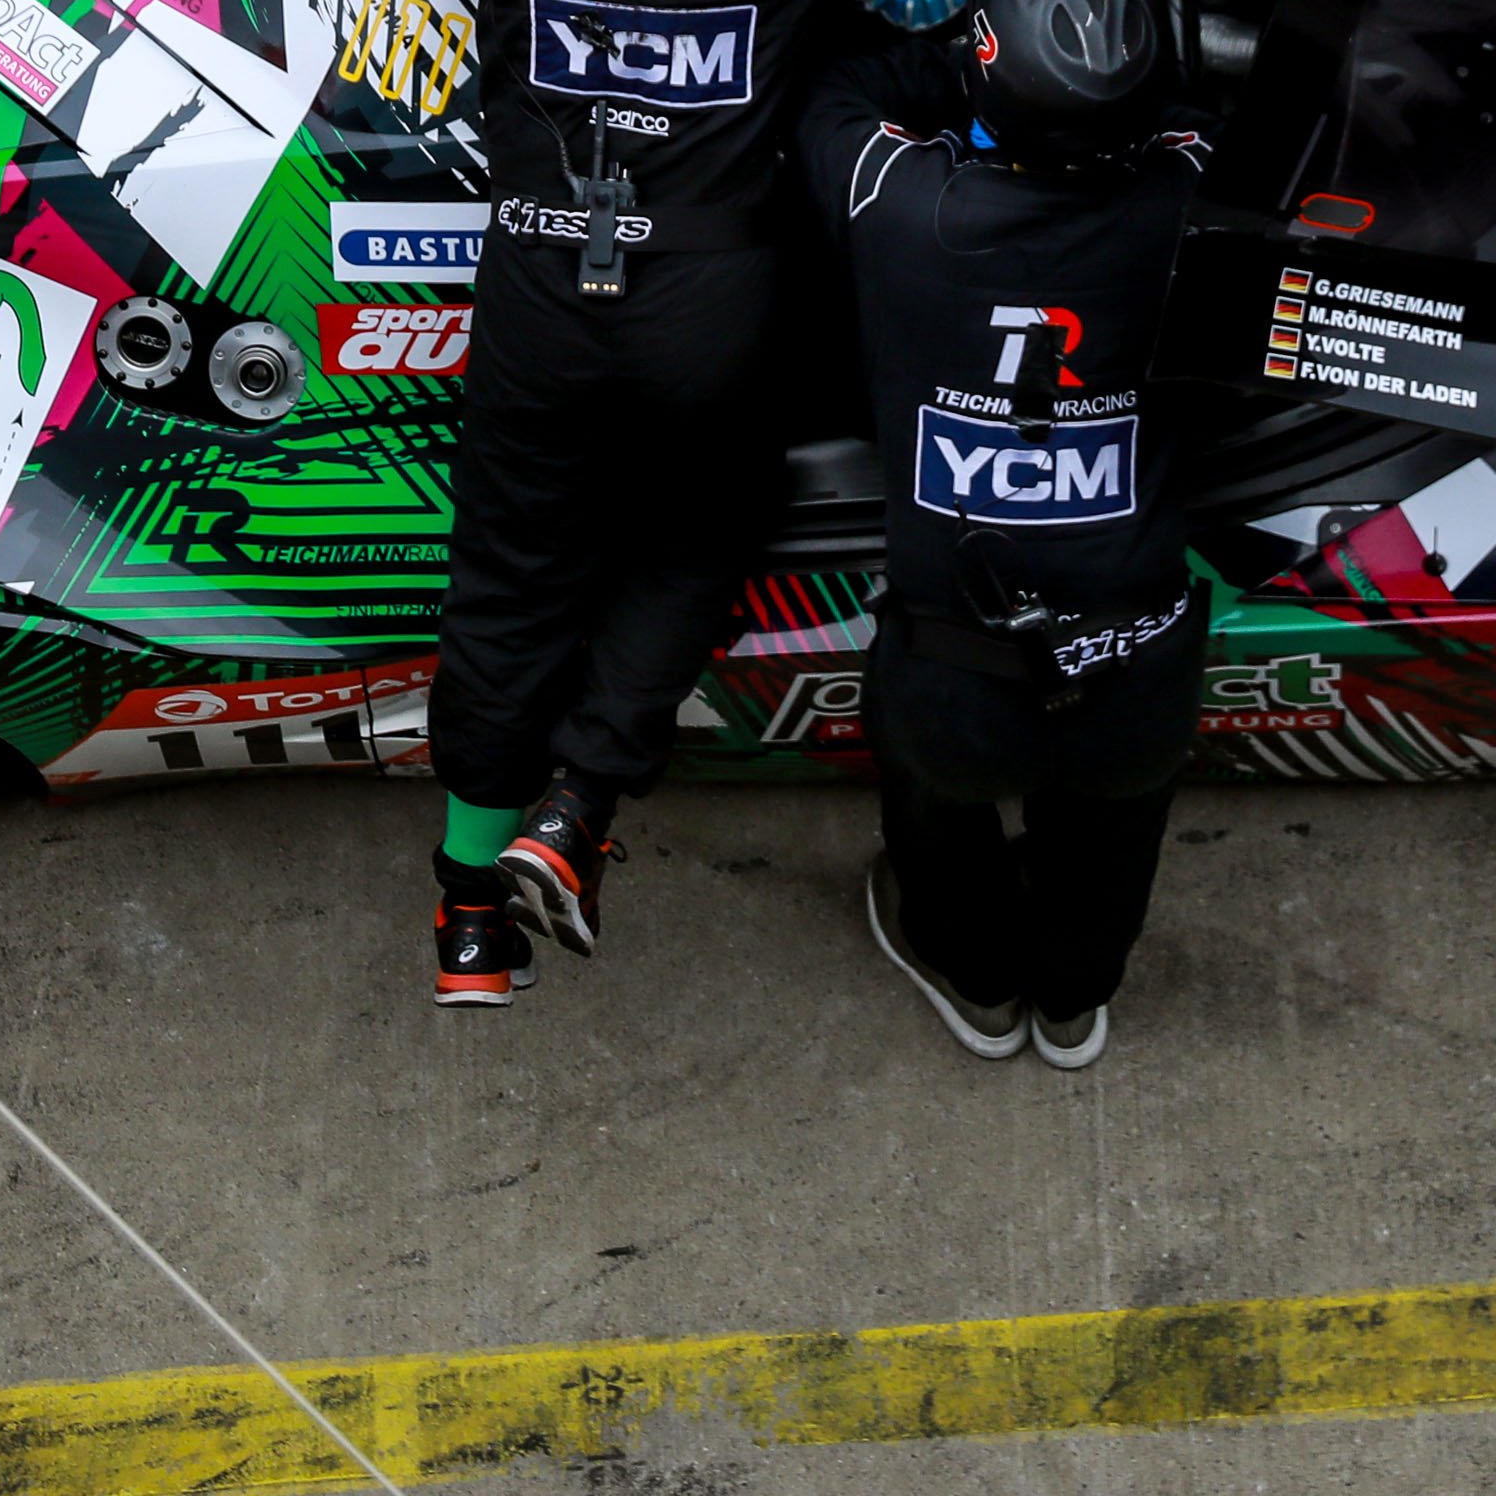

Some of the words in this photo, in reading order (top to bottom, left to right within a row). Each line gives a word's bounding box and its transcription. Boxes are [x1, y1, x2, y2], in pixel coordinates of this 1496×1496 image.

[545, 18, 737, 87] YCM
[1314, 278, 1466, 323] G.GRIESEMANN
[1304, 332, 1387, 364] Y.VOLTE
[1307, 305, 1464, 351] M.RÖNNEFARTH
[1299, 361, 1361, 388] F.VON
[1363, 372, 1407, 396] DER
[1409, 380, 1478, 409] LADEN
[932, 434, 1121, 502] YCM
[236, 669, 434, 712] TOTAL
[146, 707, 371, 770] 111
